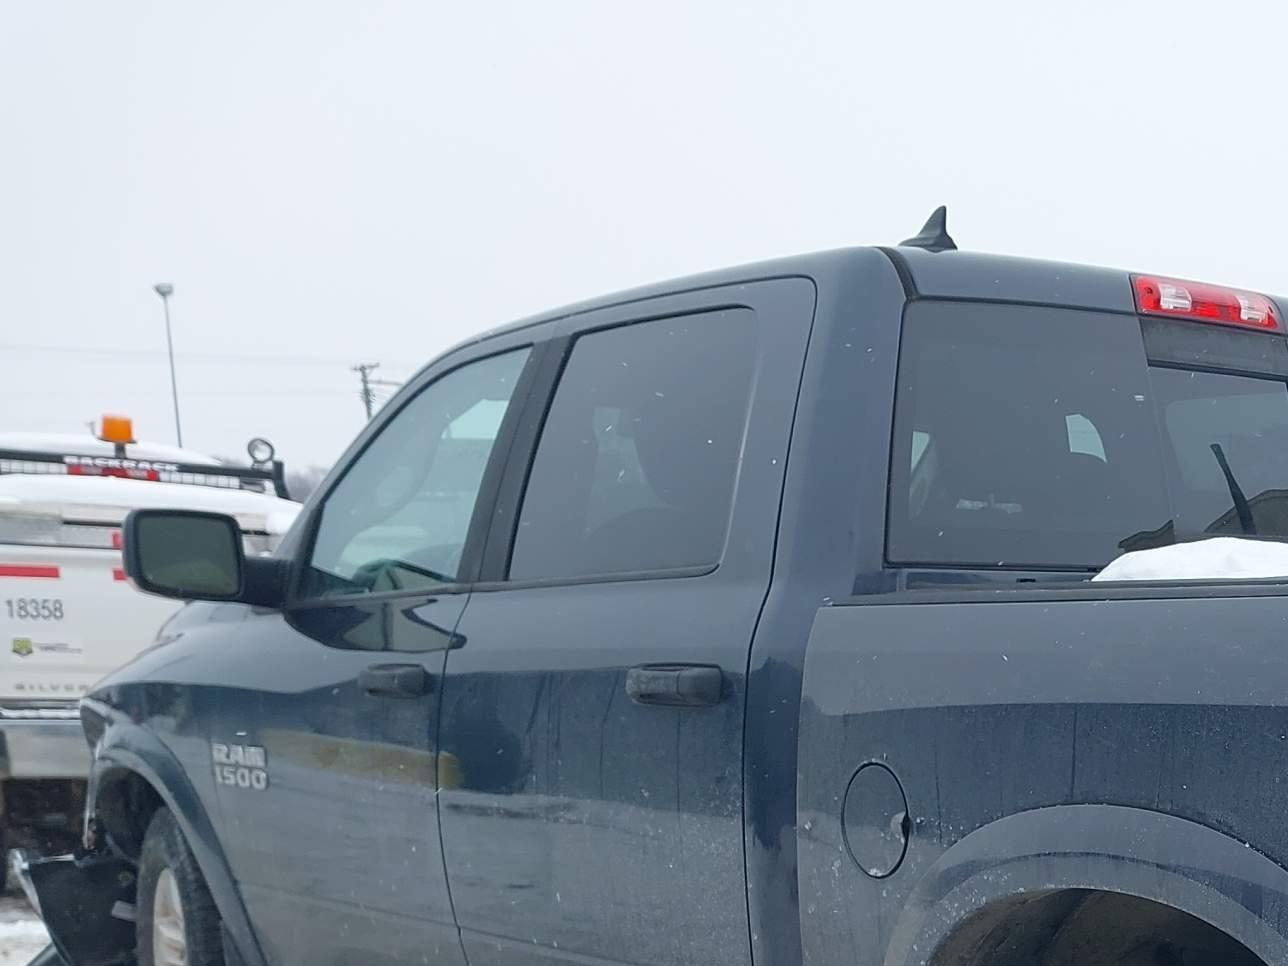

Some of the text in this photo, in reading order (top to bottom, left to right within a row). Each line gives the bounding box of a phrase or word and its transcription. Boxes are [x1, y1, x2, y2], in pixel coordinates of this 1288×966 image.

[63, 455, 179, 471] BACKRACK
[6, 598, 64, 619] 18358
[212, 743, 266, 767] RAM
[214, 765, 268, 790] 1500
